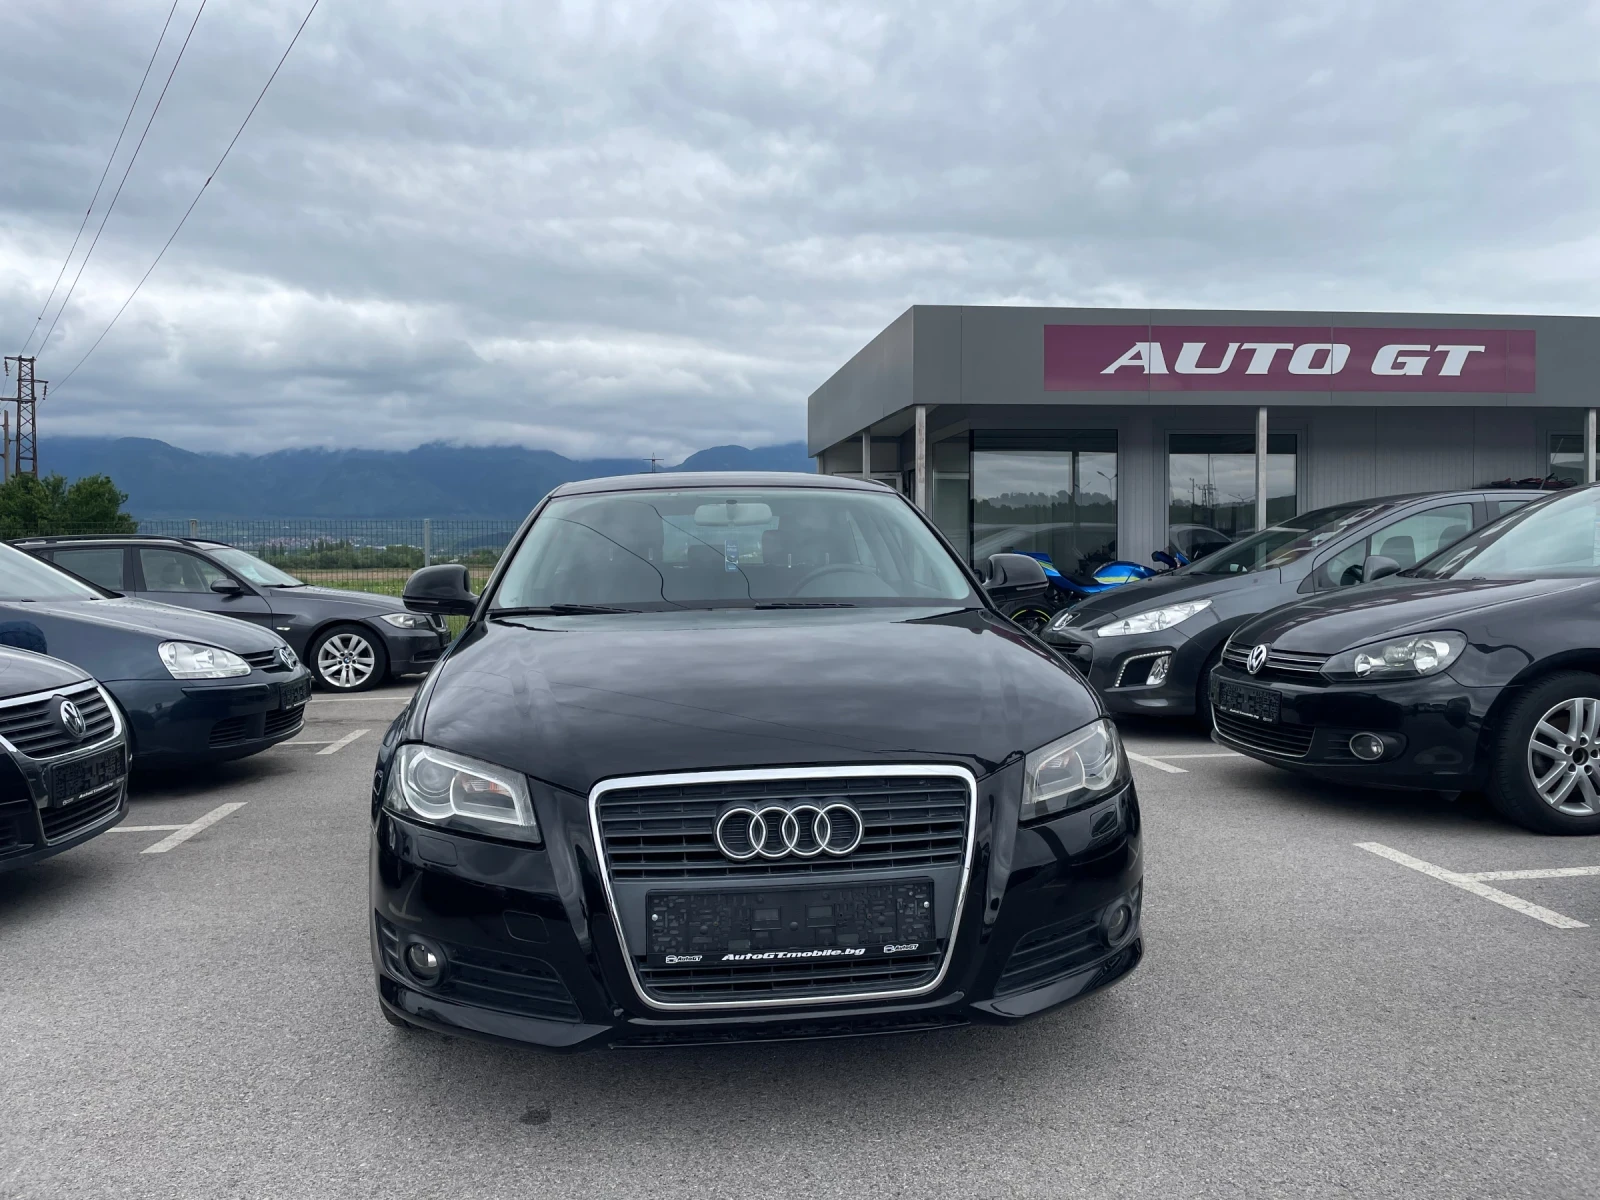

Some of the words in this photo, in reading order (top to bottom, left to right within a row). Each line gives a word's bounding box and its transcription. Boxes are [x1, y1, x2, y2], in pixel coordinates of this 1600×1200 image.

[1100, 341, 1351, 375] AUTO
[1371, 344, 1486, 376] GT
[721, 948, 866, 961] AutoGT.mobile.bg
